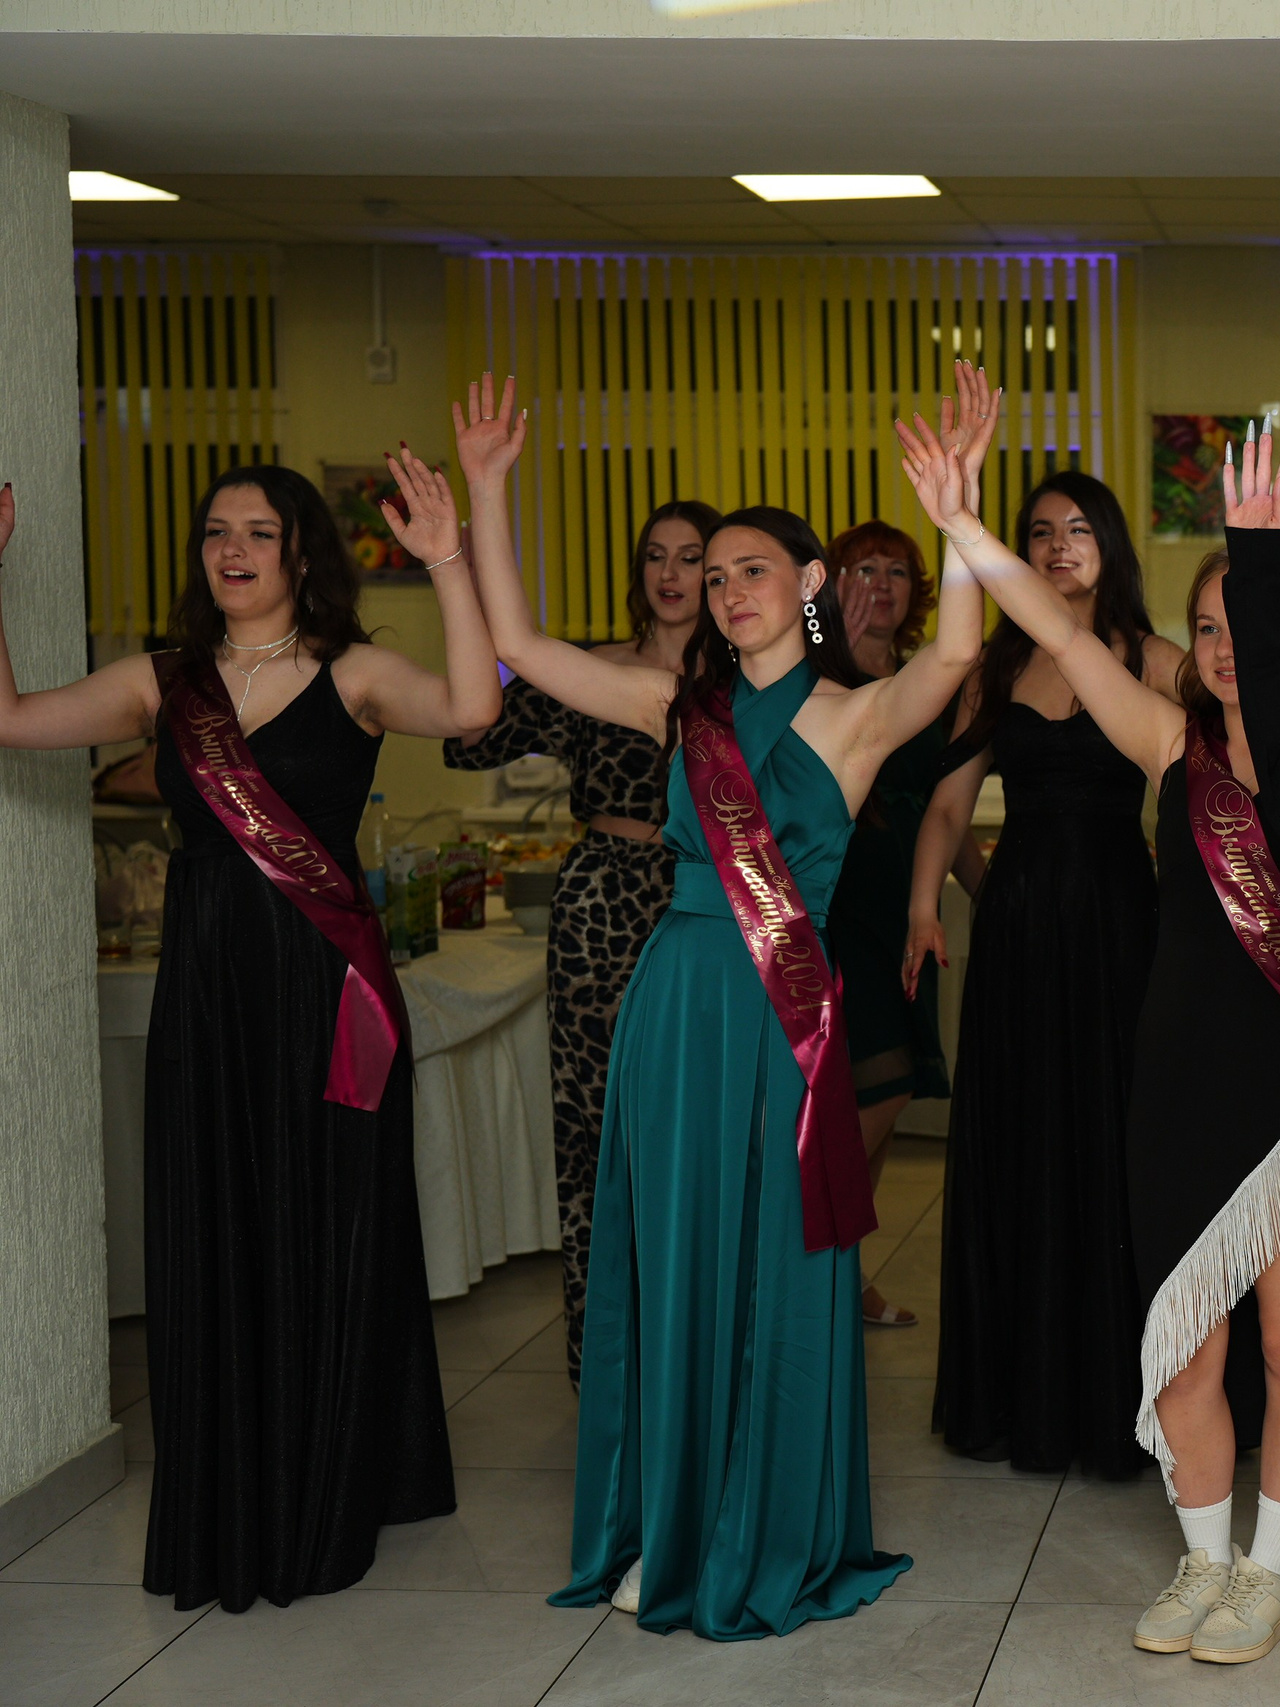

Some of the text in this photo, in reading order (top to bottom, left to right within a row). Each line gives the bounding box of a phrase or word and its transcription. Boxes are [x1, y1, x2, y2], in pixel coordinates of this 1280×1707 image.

[709, 769, 831, 1012] Выпускница 2024
[772, 875, 796, 917] Надежда
[1224, 893, 1244, 914] СШ
[740, 916, 752, 928] 119
[1233, 914, 1251, 931] №
[1241, 932, 1254, 944] 119
